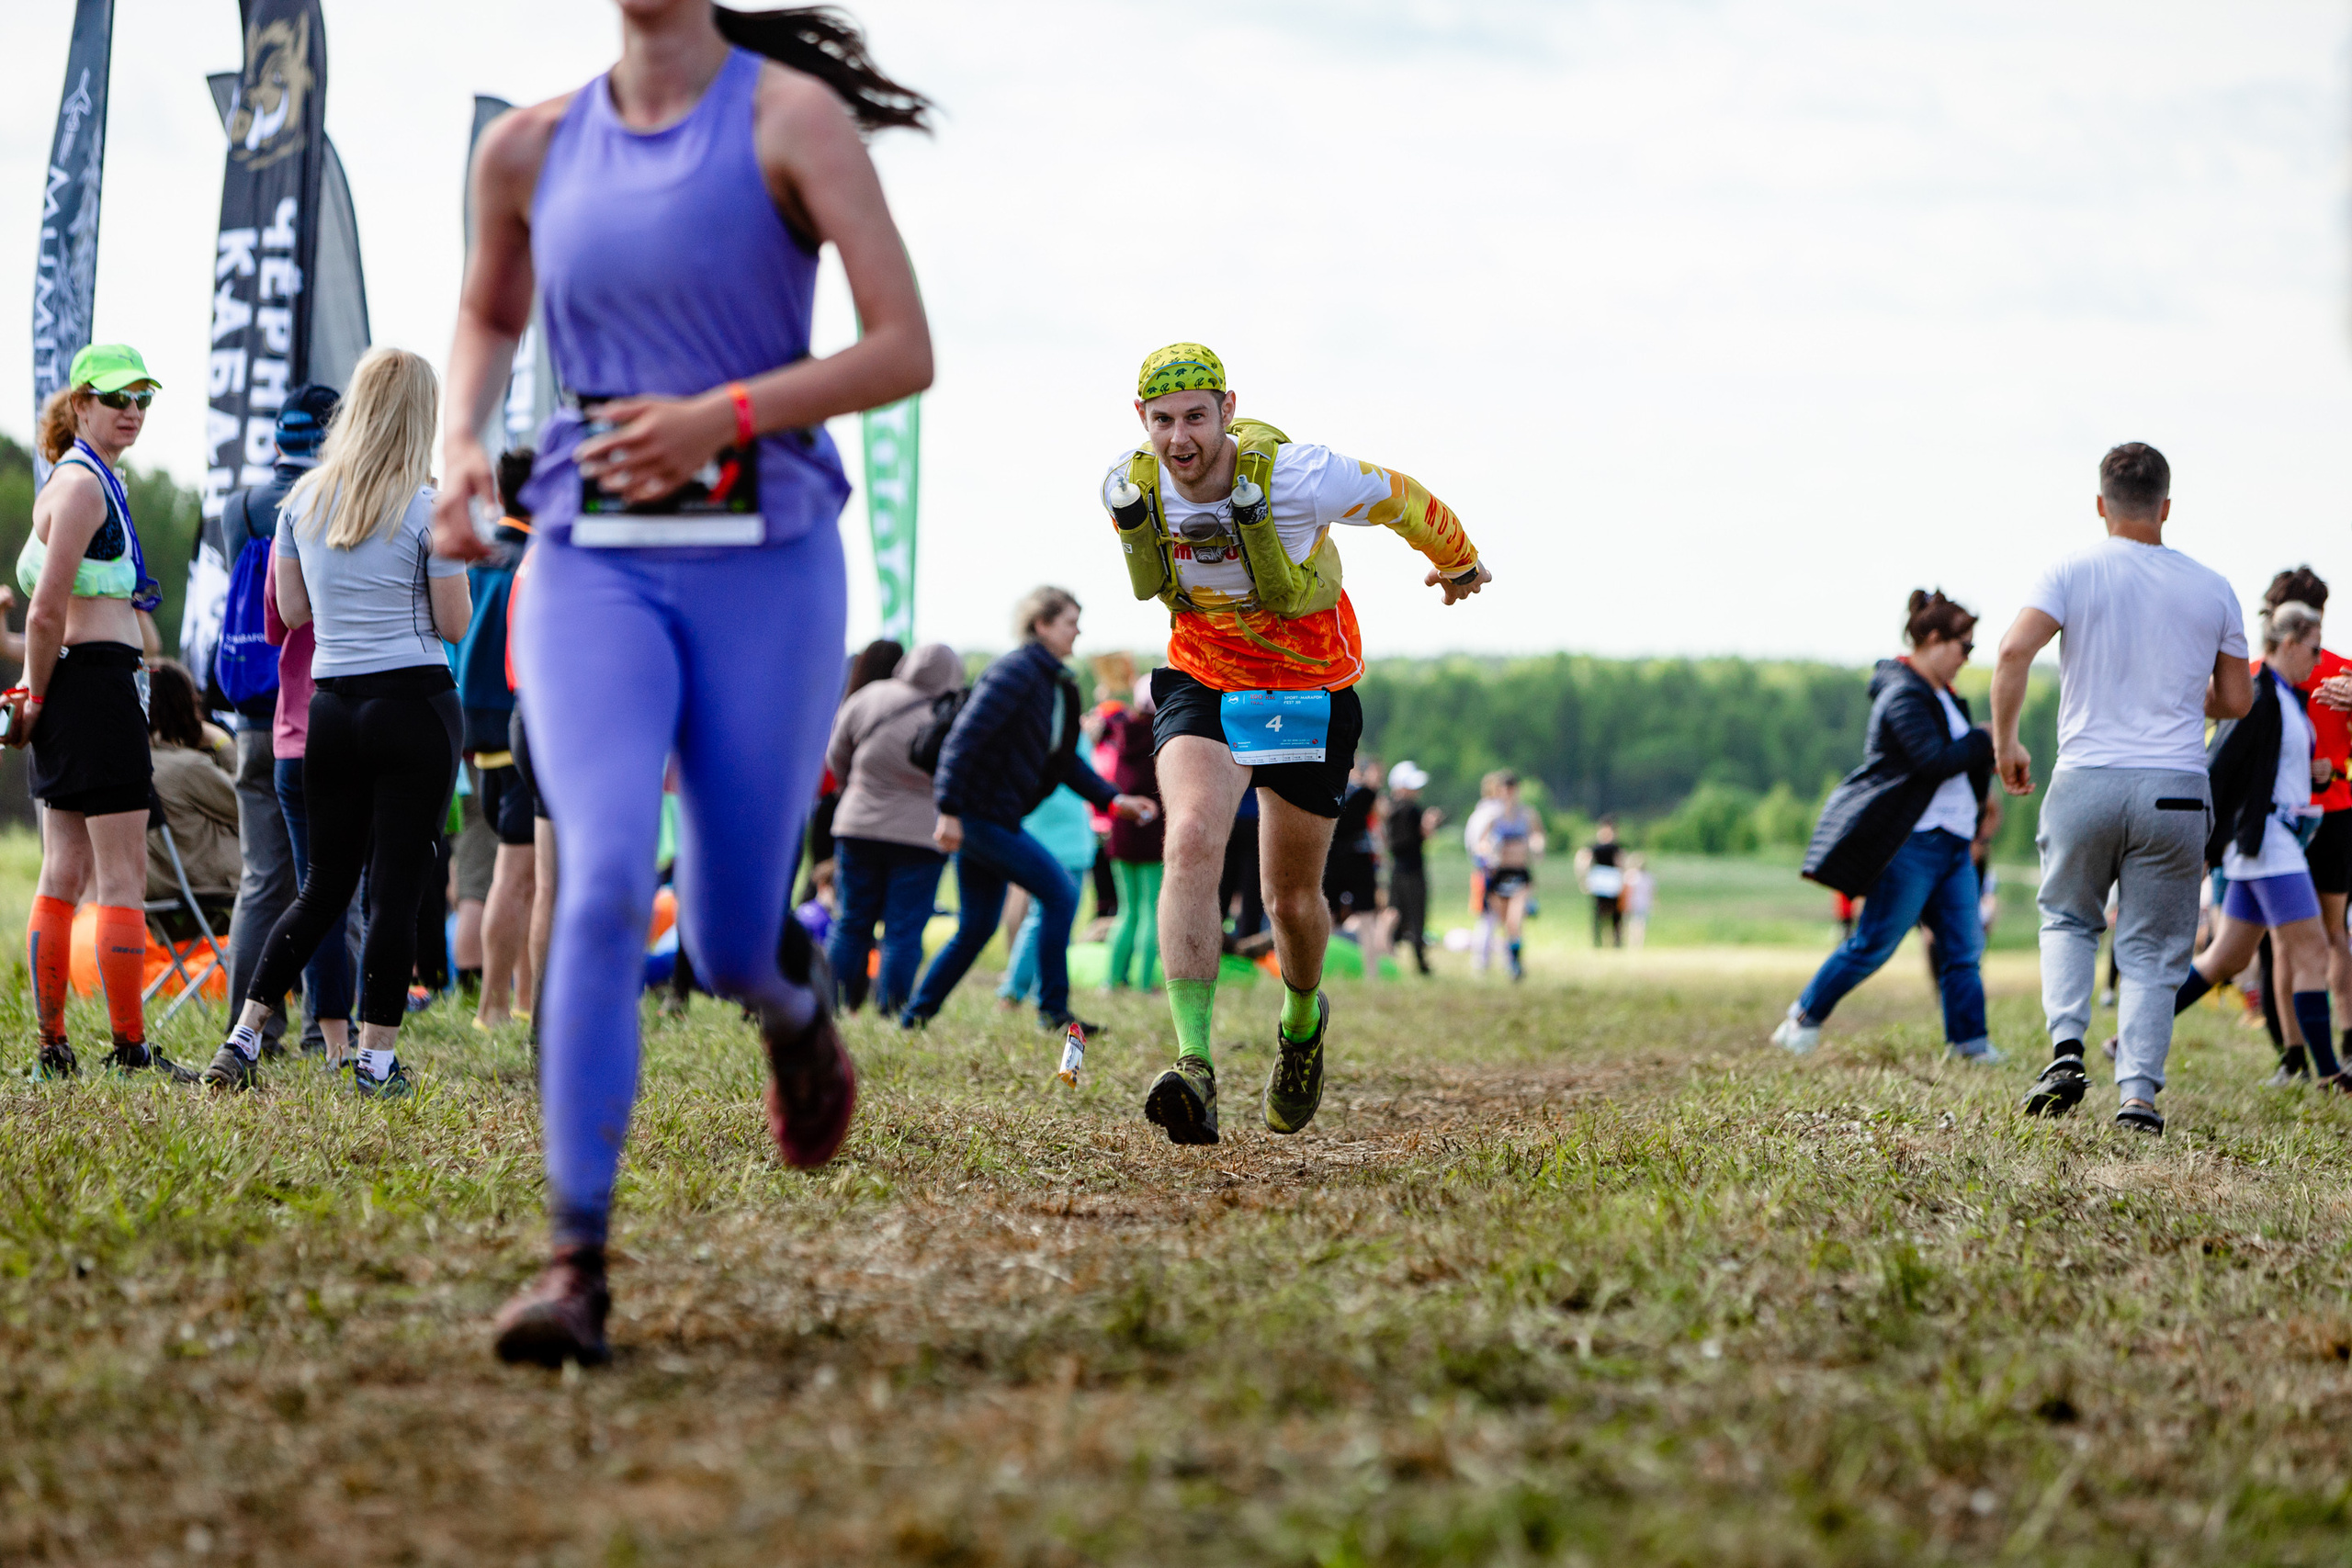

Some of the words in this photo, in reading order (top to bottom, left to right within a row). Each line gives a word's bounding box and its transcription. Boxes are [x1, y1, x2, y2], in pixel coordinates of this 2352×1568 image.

[204, 228, 259, 519] КАБАН
[241, 196, 304, 487] ЧЁРНЫ
[1265, 715, 1283, 732] 4
